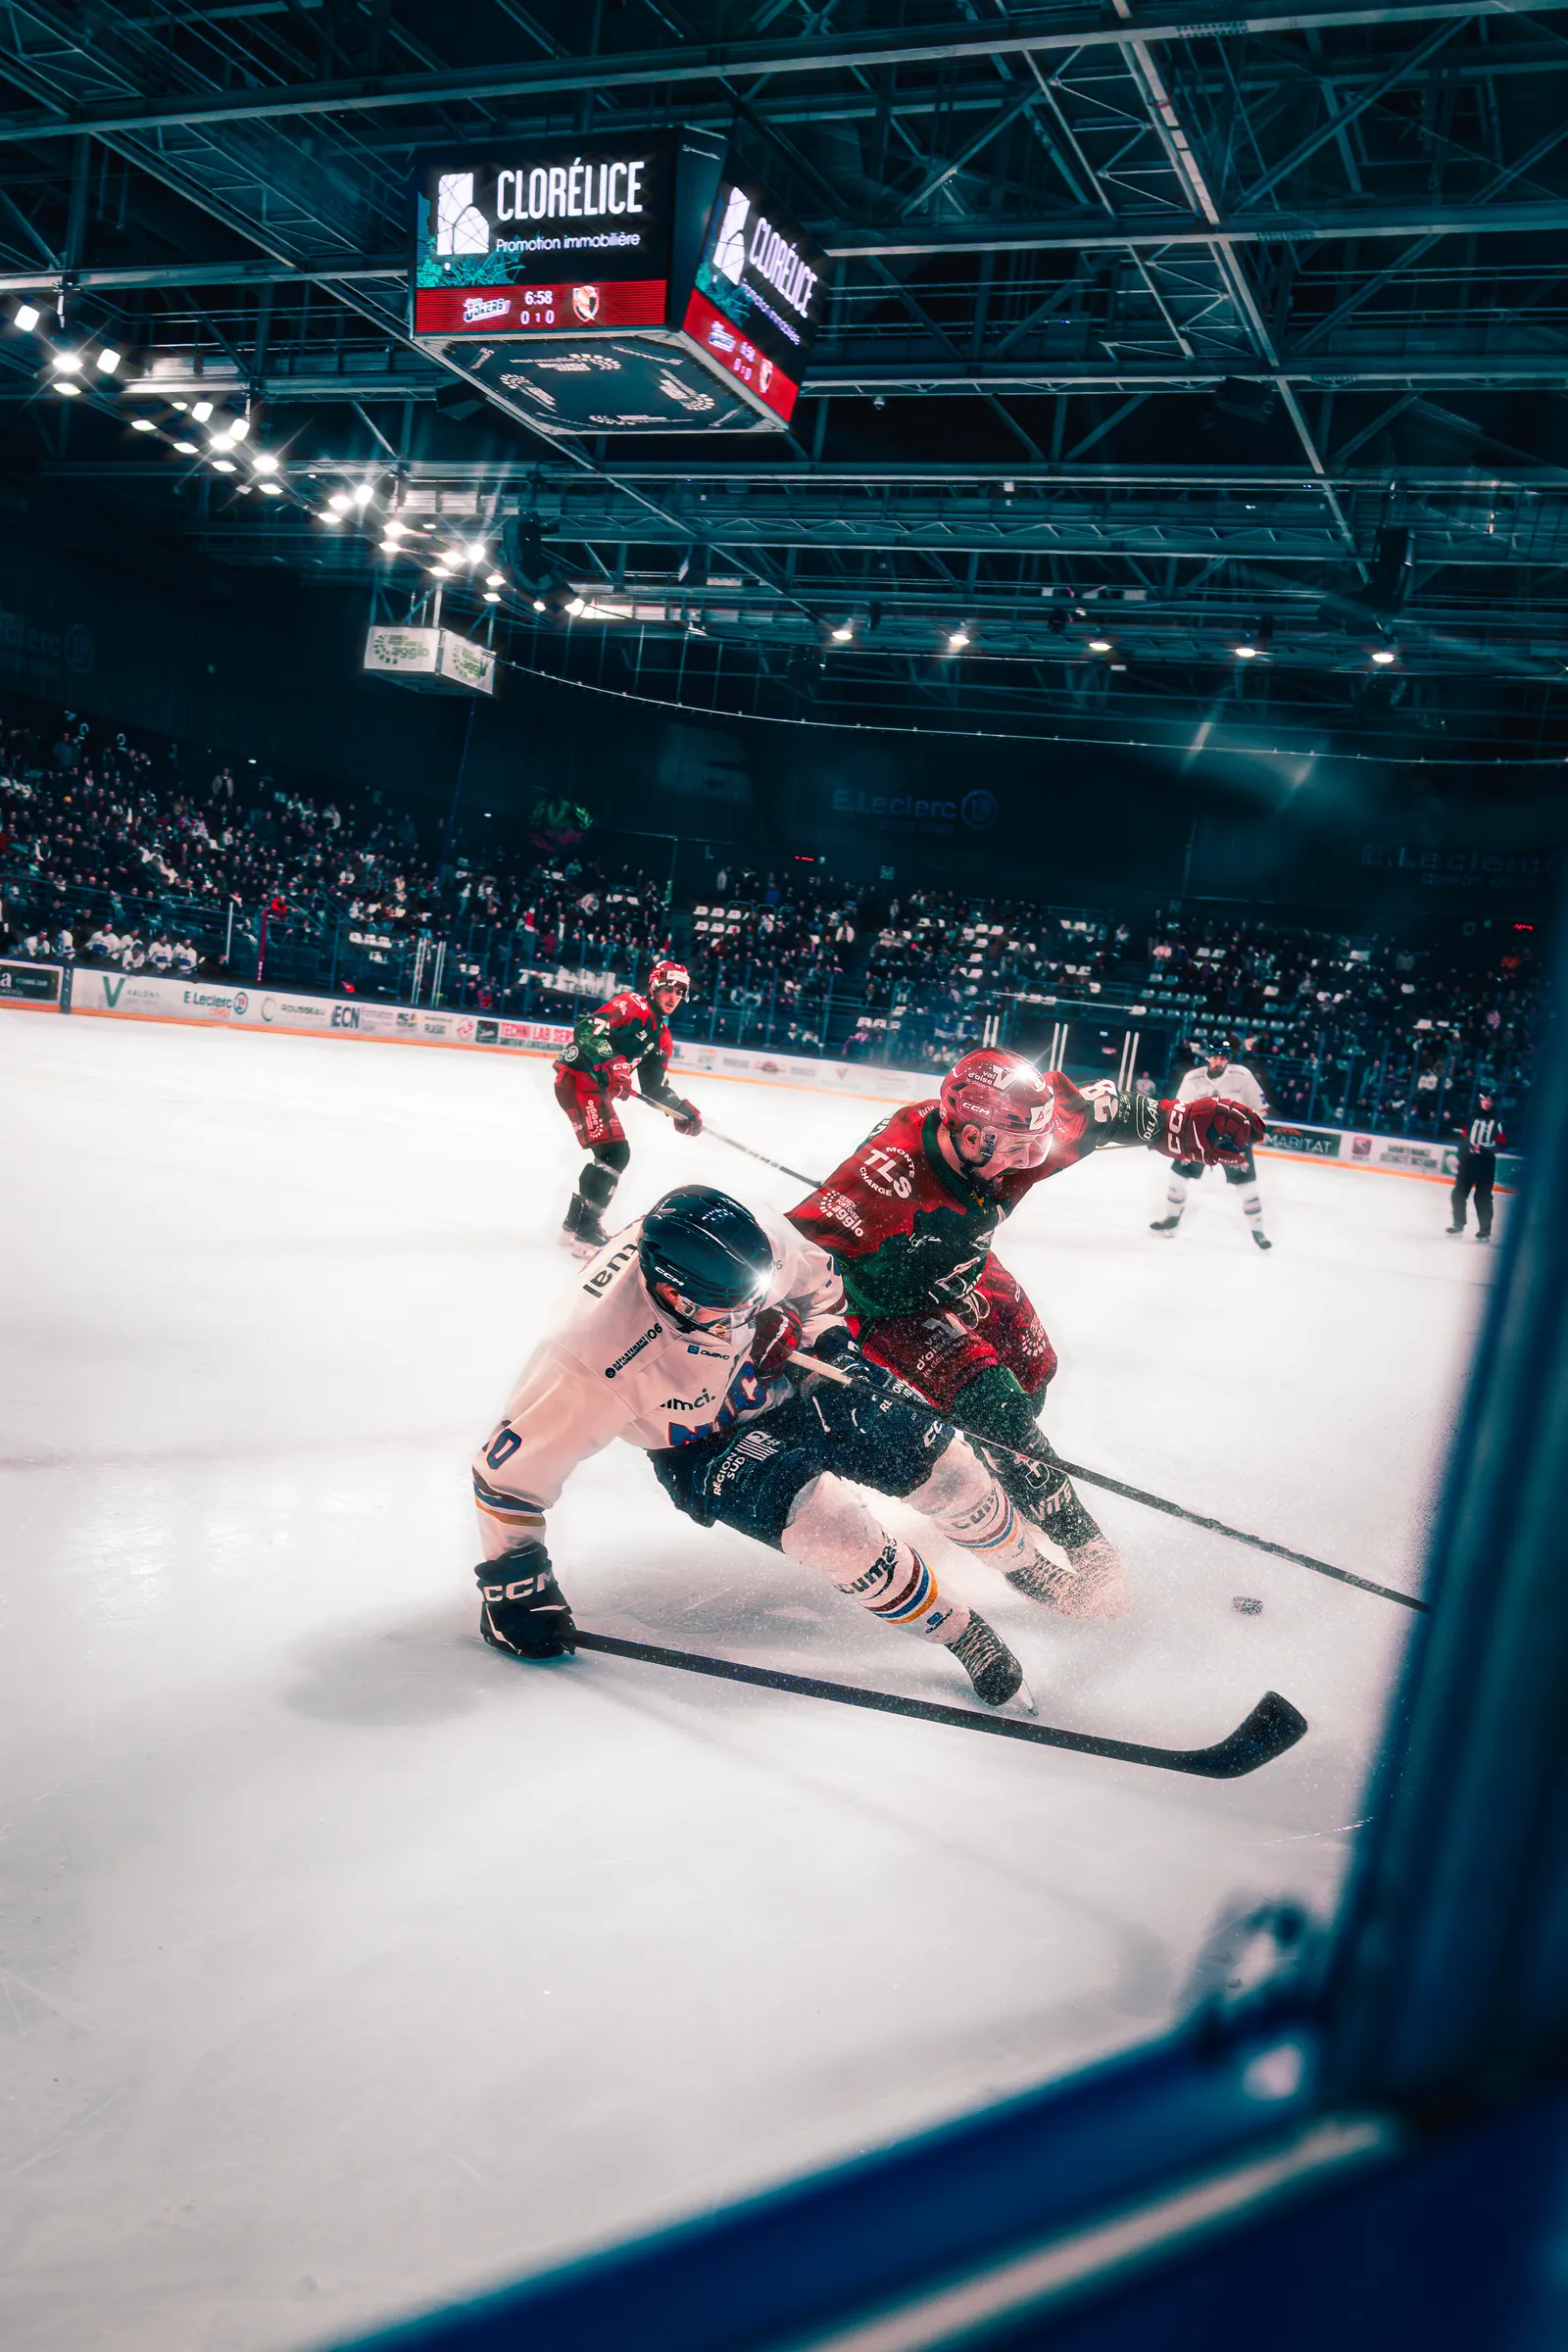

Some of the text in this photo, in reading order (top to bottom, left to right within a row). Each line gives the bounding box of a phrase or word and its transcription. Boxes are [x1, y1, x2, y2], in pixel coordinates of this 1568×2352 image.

[497, 158, 644, 221] CLORÉLICE
[496, 232, 640, 253] Promotion immobilière
[749, 217, 817, 318] CLORÉLICE
[524, 290, 553, 306] 6:58
[968, 1071, 994, 1085] d'oise
[982, 1070, 997, 1080] val
[962, 1102, 991, 1115] CCM
[863, 1149, 912, 1199] TLS
[886, 1147, 915, 1179] MONTE
[859, 1166, 893, 1197] CHARGE
[831, 1205, 864, 1237] agglo
[655, 1266, 685, 1286] CCM
[726, 1456, 745, 1480] SUD
